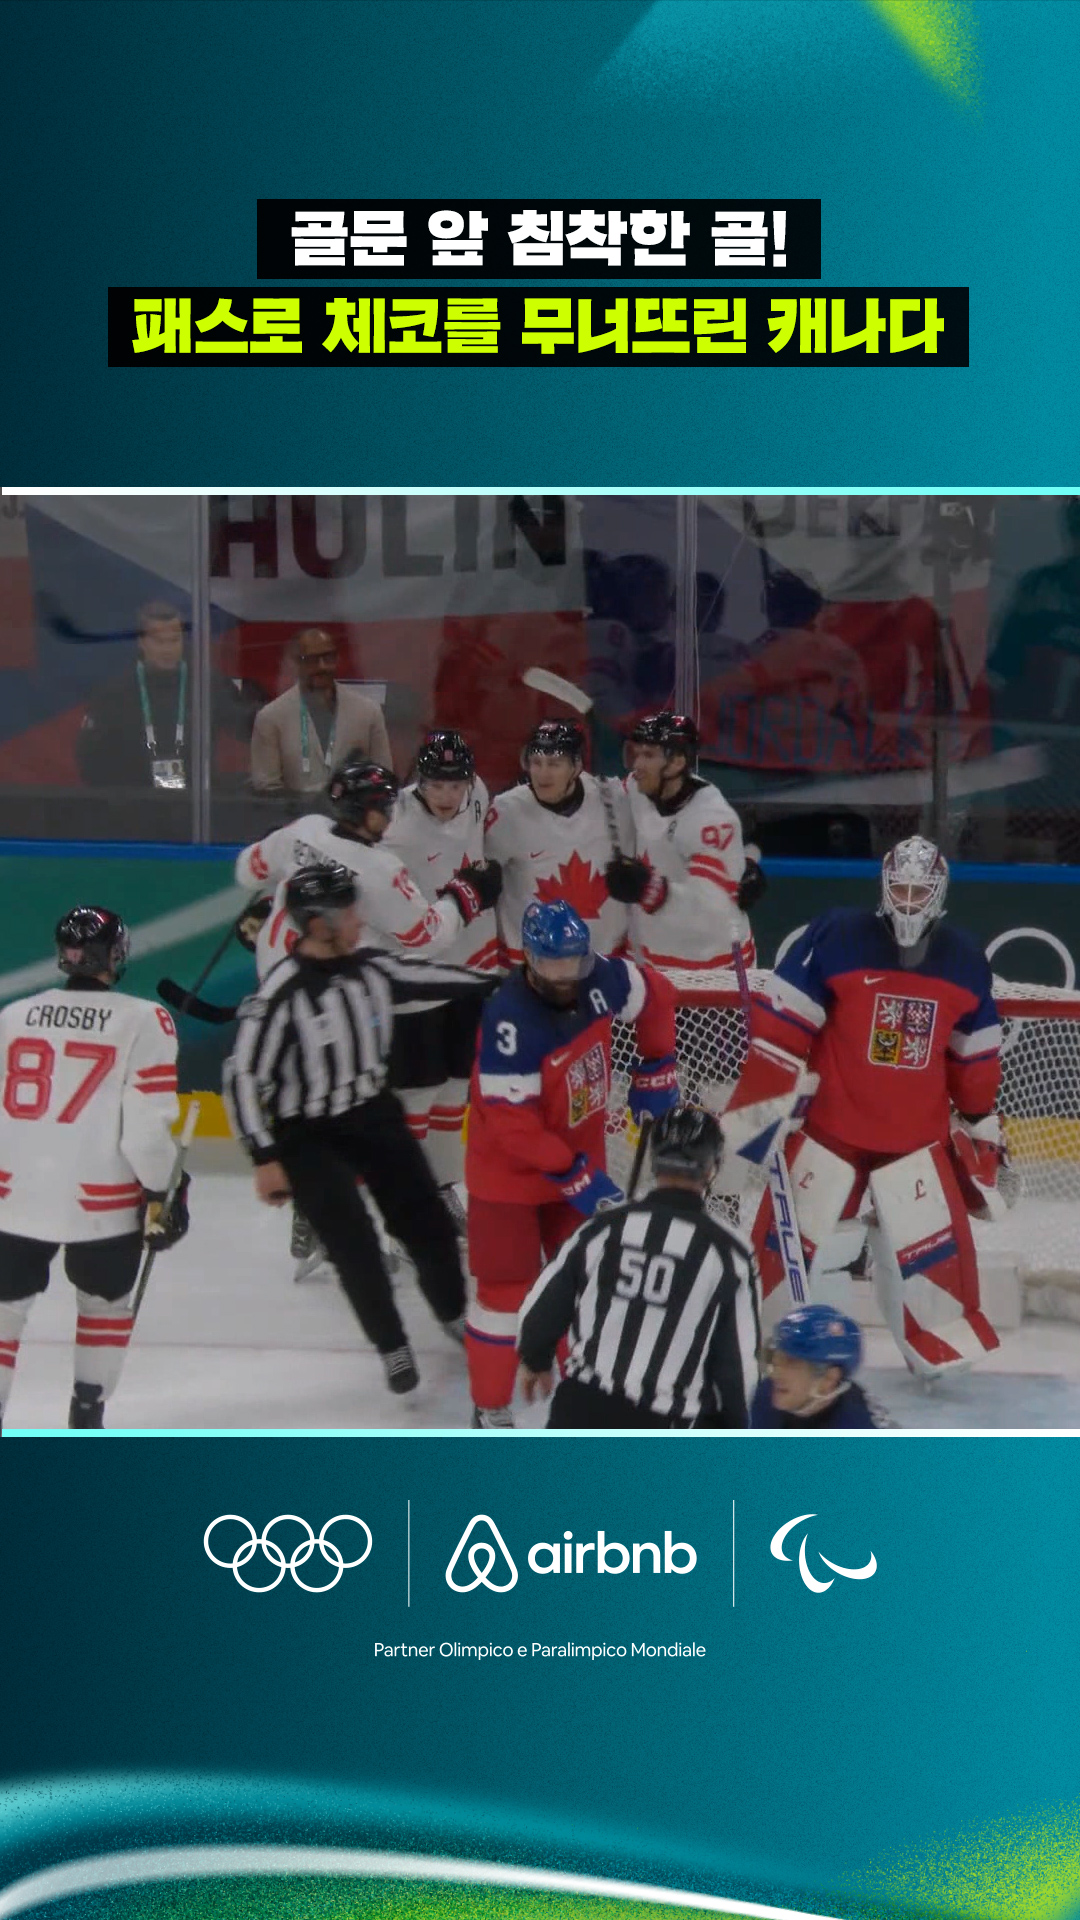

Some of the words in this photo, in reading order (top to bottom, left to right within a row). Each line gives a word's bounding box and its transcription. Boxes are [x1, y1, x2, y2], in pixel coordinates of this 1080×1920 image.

[701, 824, 735, 850] 97
[588, 987, 609, 1016] A
[25, 1004, 113, 1032] CROSBY
[155, 1007, 176, 1036] 8
[494, 1021, 517, 1058] 3
[3, 1037, 117, 1124] 87
[616, 1243, 676, 1306] 50
